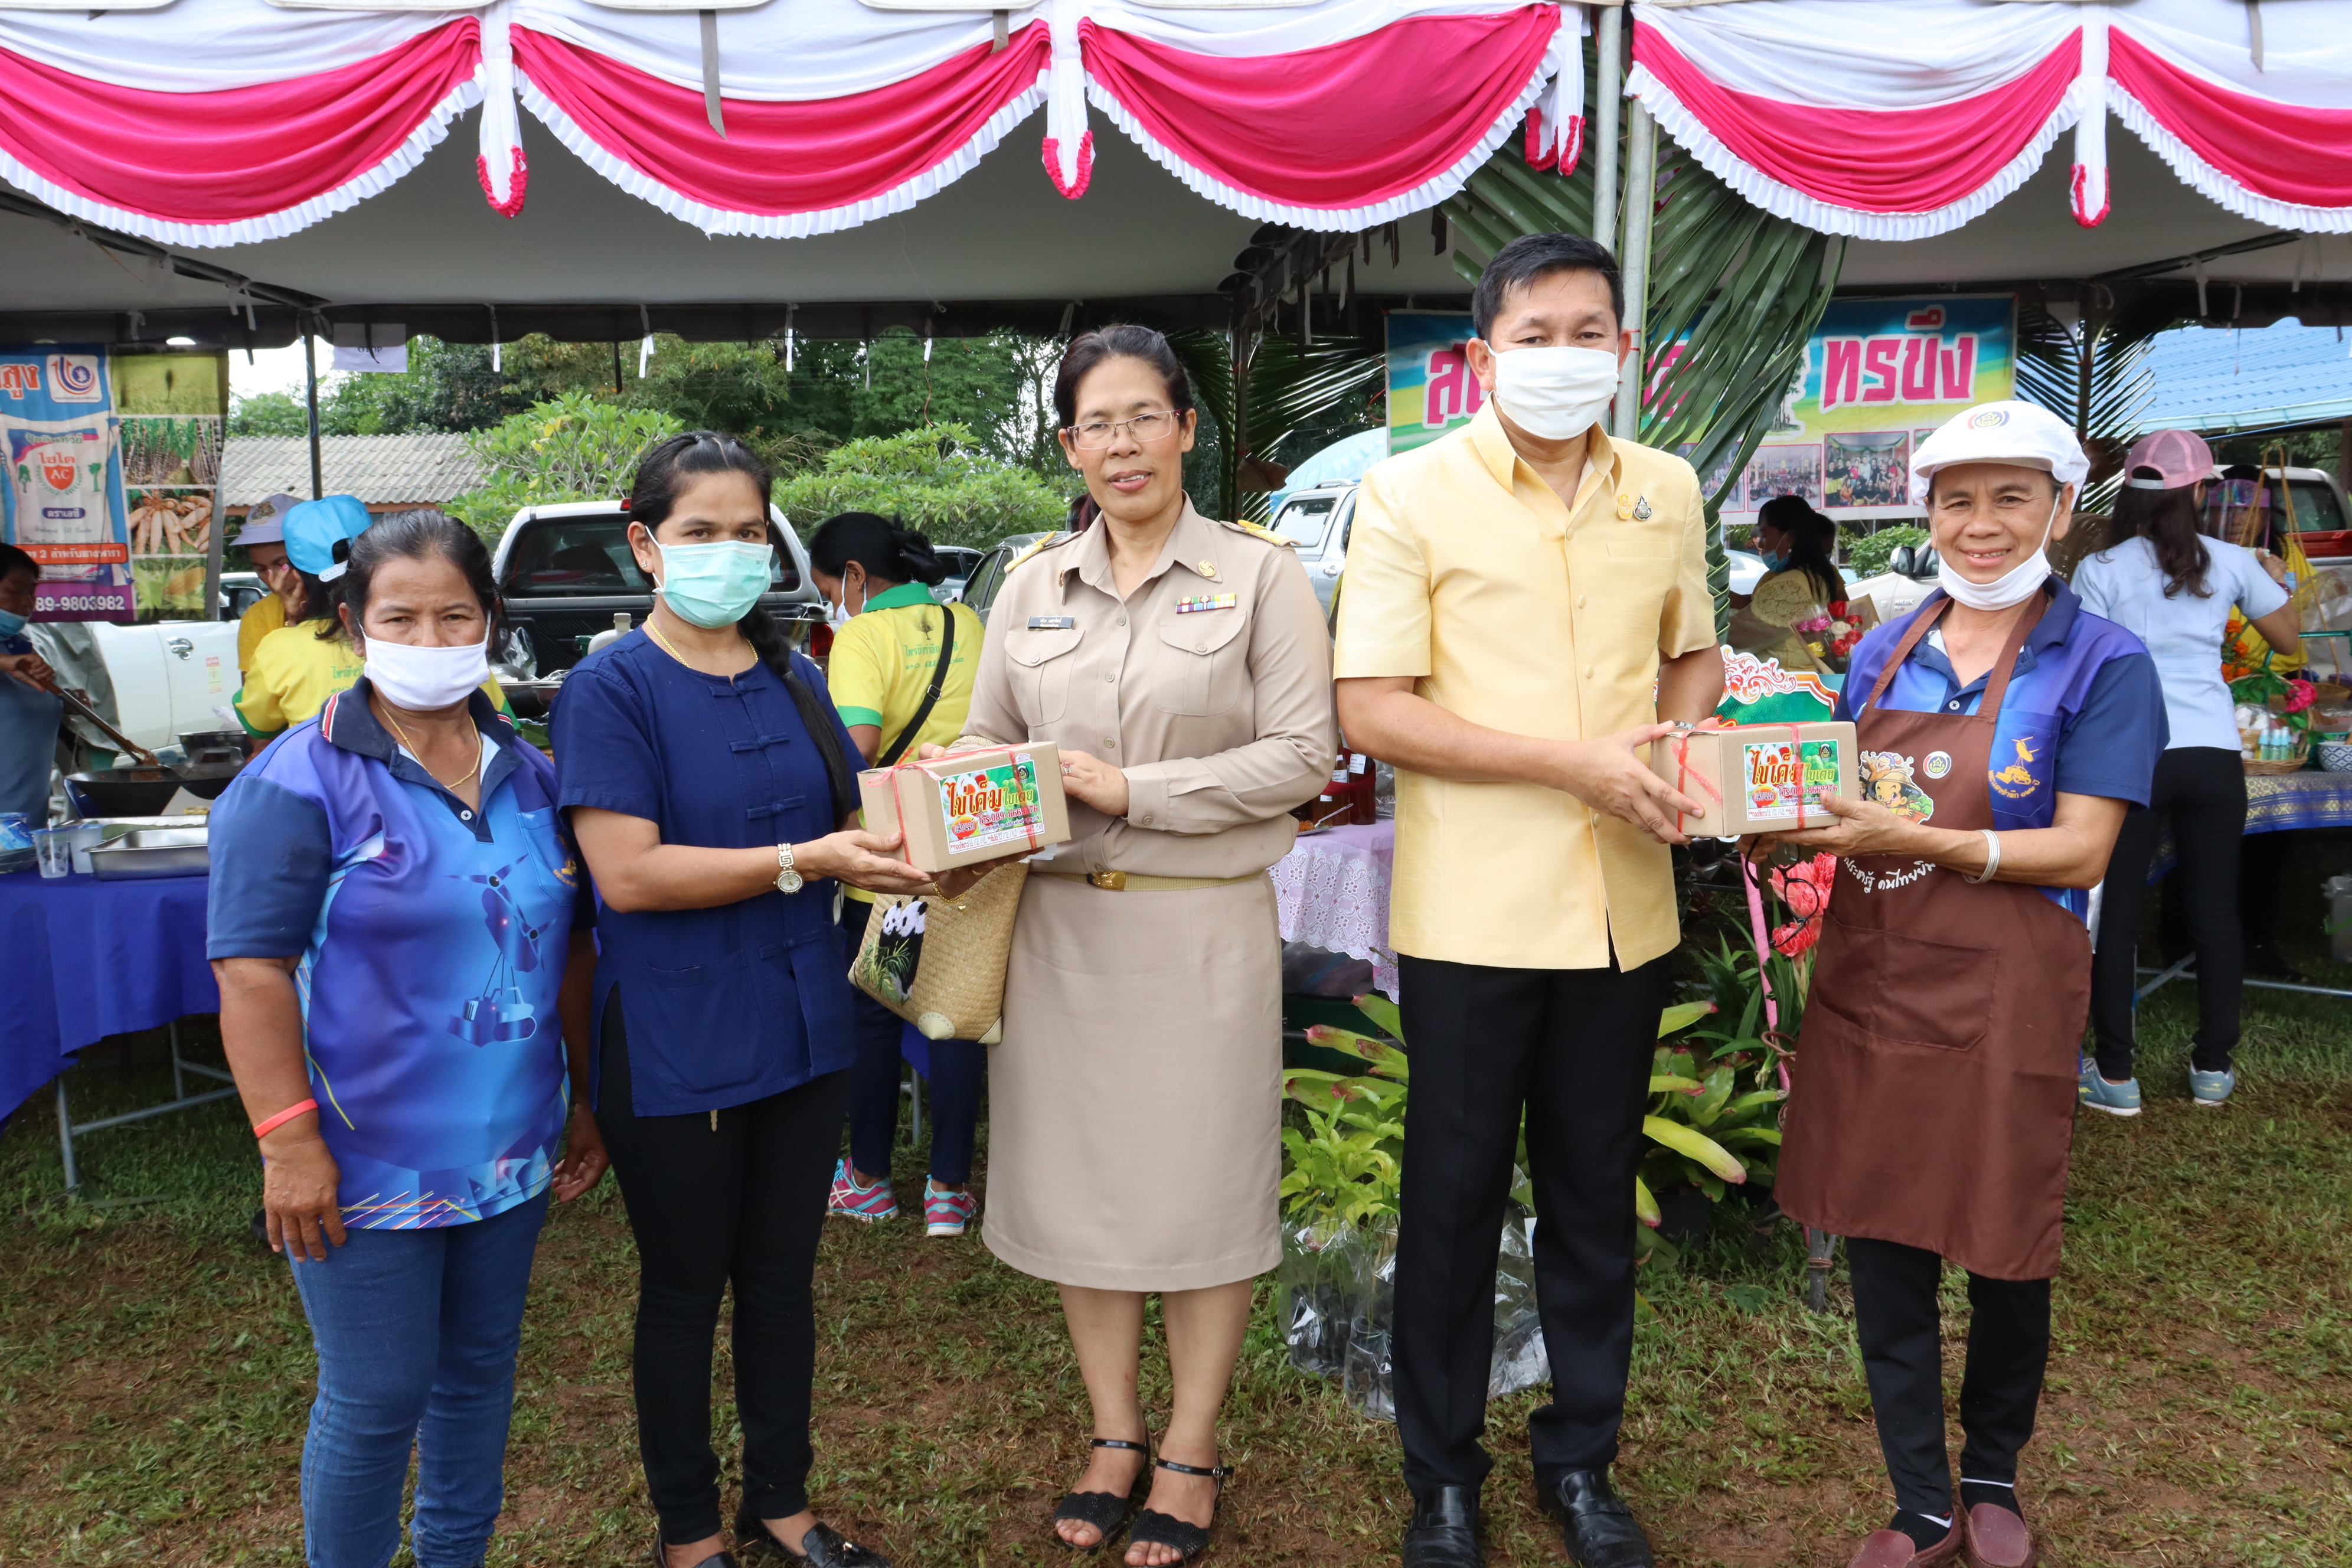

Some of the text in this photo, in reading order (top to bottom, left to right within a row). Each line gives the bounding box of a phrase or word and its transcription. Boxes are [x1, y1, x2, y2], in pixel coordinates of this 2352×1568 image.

[0, 365, 39, 398] สูง
[51, 469, 70, 479] AC
[40, 550, 47, 558] 2
[35, 596, 125, 612] 89-9803982
